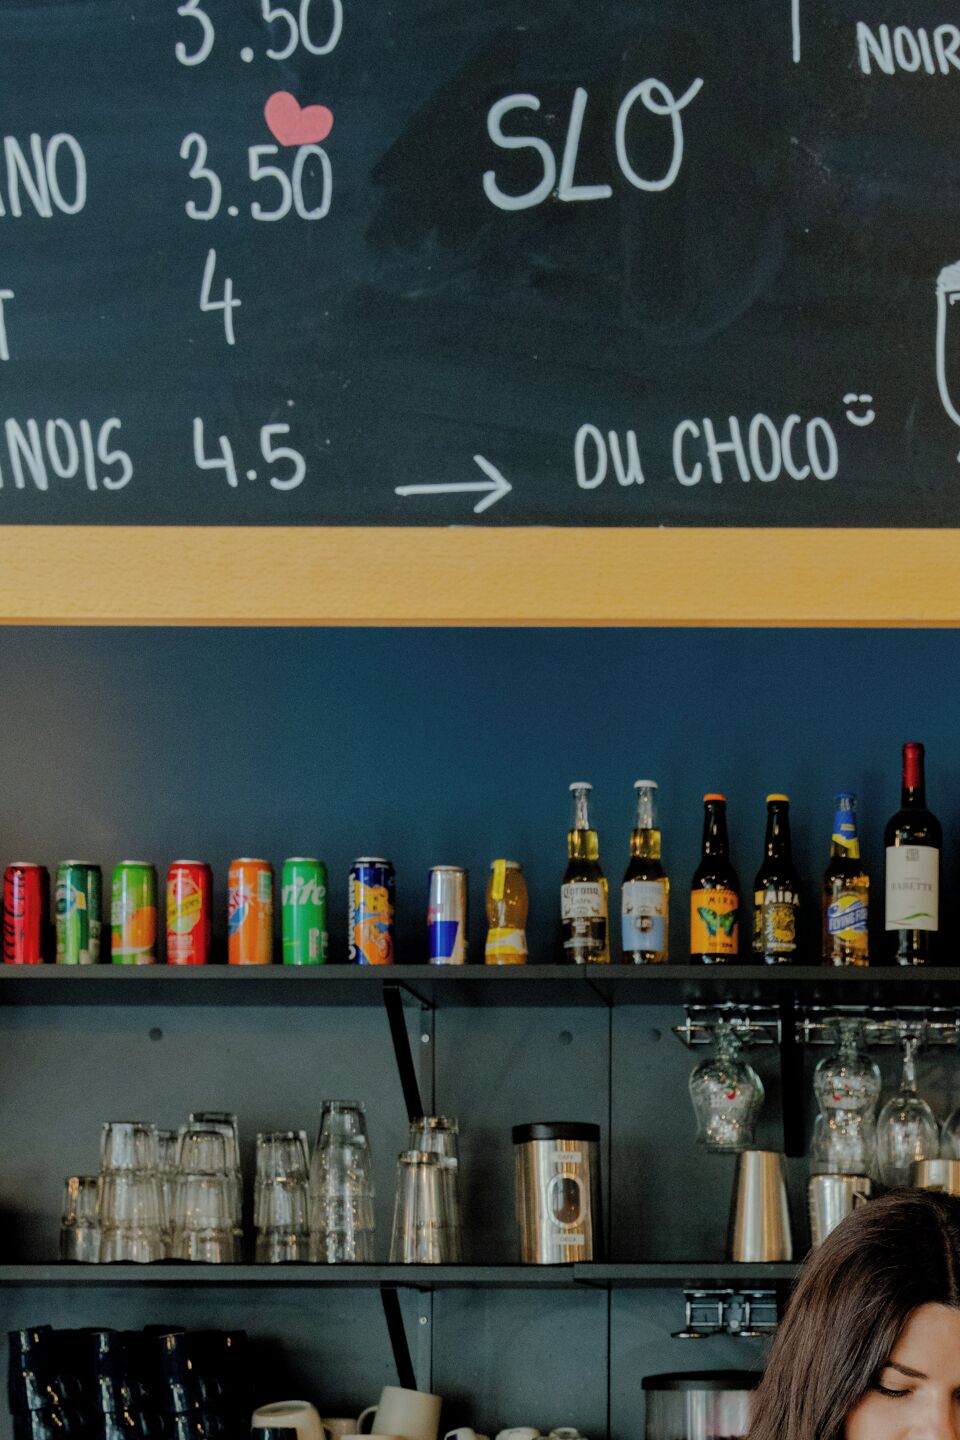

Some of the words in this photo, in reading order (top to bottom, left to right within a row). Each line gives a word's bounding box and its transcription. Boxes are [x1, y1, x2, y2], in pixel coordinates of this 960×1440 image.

[175, 0, 343, 66] 3.50
[0, 132, 87, 217] NO
[180, 132, 333, 220] 3.50
[482, 77, 703, 211] SLO
[200, 248, 242, 345] 4
[0, 417, 133, 491] NOIS
[193, 417, 306, 490] 4.5
[574, 423, 644, 488] OU
[672, 413, 838, 485] CHOCO
